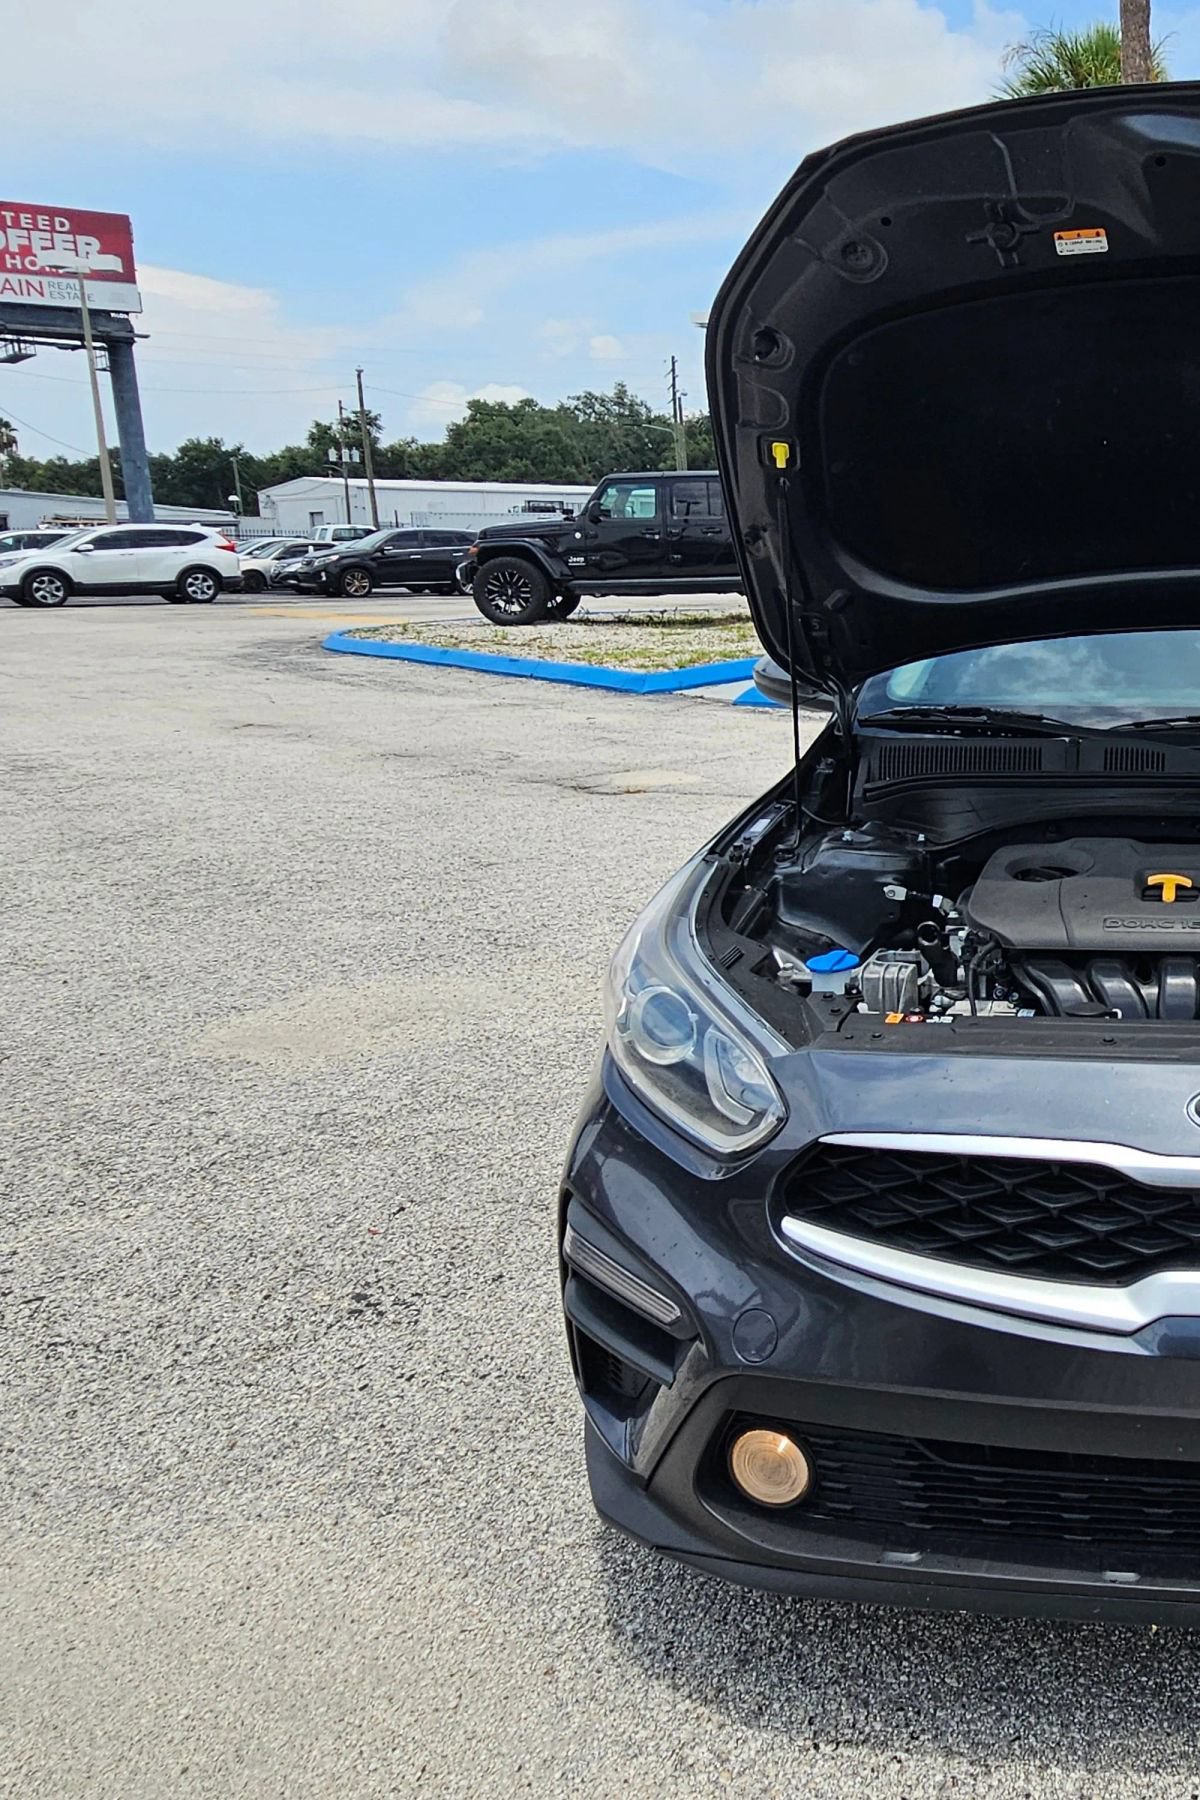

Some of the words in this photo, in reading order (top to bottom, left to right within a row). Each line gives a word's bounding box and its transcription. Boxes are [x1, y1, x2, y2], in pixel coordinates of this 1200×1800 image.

[1, 211, 70, 232] TEED
[47, 280, 81, 292] REAL
[49, 290, 96, 302] ESTAE
